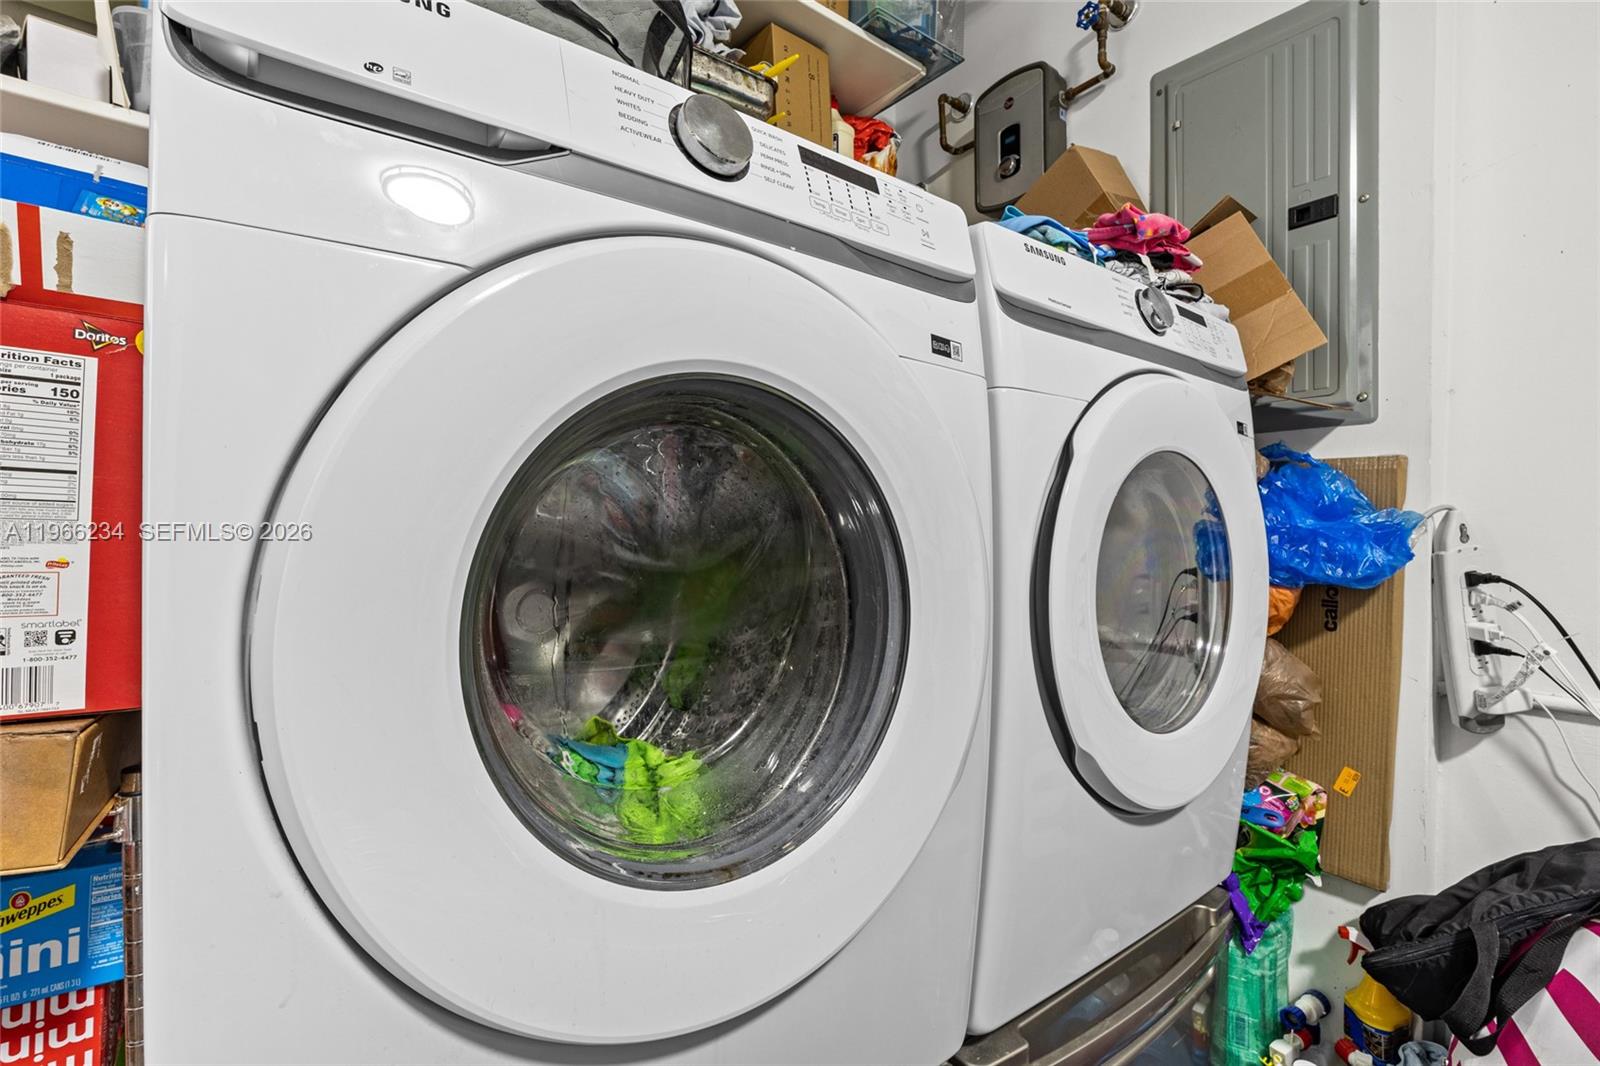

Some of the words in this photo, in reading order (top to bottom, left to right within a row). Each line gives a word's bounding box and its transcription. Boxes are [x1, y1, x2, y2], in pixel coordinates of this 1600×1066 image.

[611, 70, 640, 85] NORMAL
[614, 85, 636, 97] HEAVY
[637, 94, 655, 104] DUTY
[616, 98, 642, 112] WHITES
[618, 111, 648, 127] BEDDING
[620, 125, 662, 143] ACTIVEWEAR
[759, 141, 786, 156] DELICATES
[1024, 242, 1066, 266] SAMSUNG
[74, 328, 127, 346] Doritos
[44, 356, 82, 367] Facts
[50, 386, 80, 399] 150
[21, 619, 81, 629] smartlabel
[23, 654, 78, 663] 1-800-352-4477
[0, 926, 81, 980] ini
[49, 980, 65, 993] CANS
